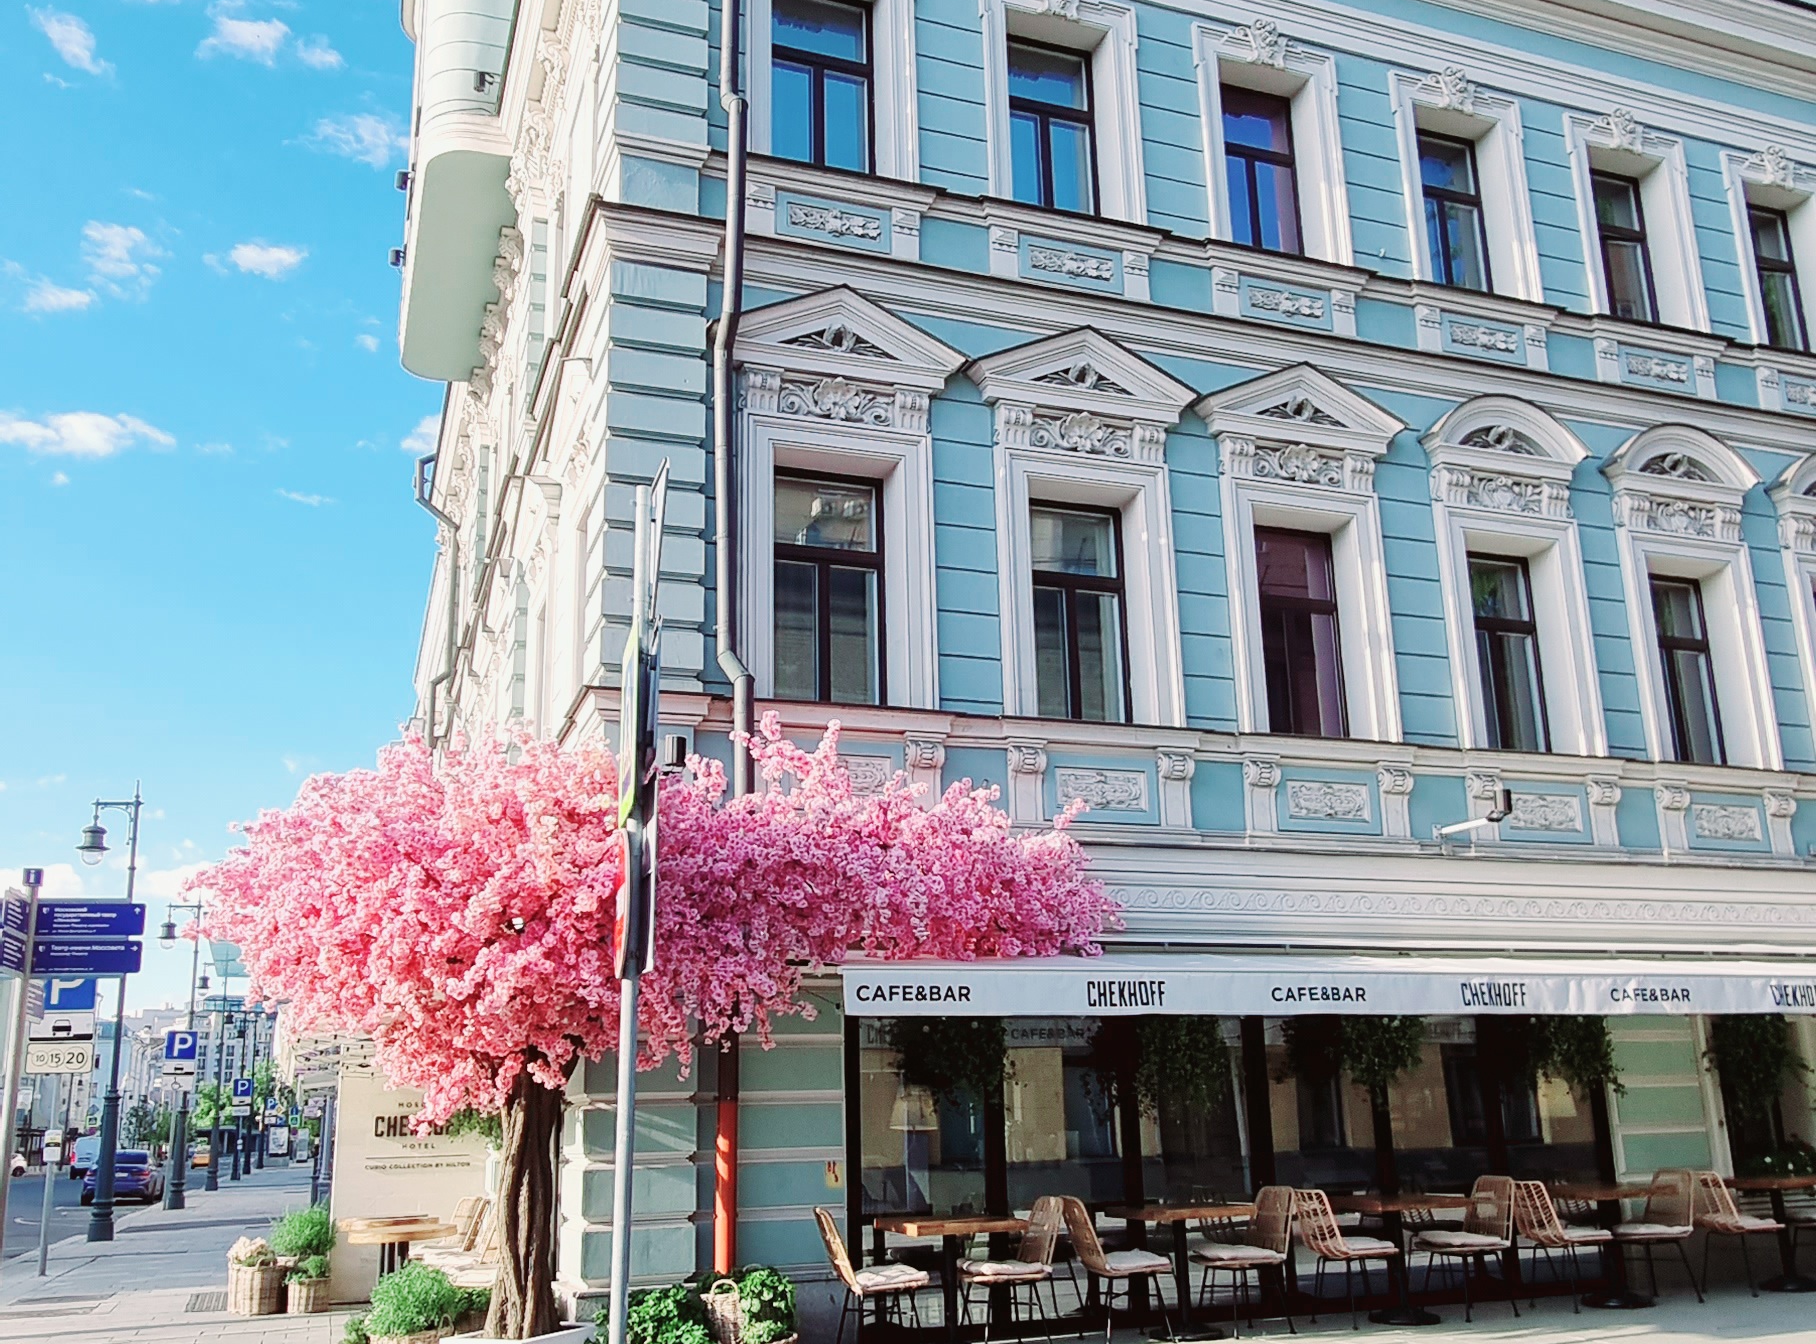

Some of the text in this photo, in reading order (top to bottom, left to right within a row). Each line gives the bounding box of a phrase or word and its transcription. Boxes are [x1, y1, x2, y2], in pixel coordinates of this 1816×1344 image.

[856, 985, 971, 1002] CAFE&BAR
[1087, 980, 1166, 1007] CHEKHOFF
[1271, 986, 1367, 1002] CAFE&BAR
[1460, 982, 1527, 1007] CHEKHOFF
[1610, 987, 1692, 1003] CAFE&BAR
[1769, 984, 1816, 1007] CHEKHO
[173, 1033, 193, 1057] P
[50, 1052, 61, 1064] 15
[66, 1052, 85, 1064] 20
